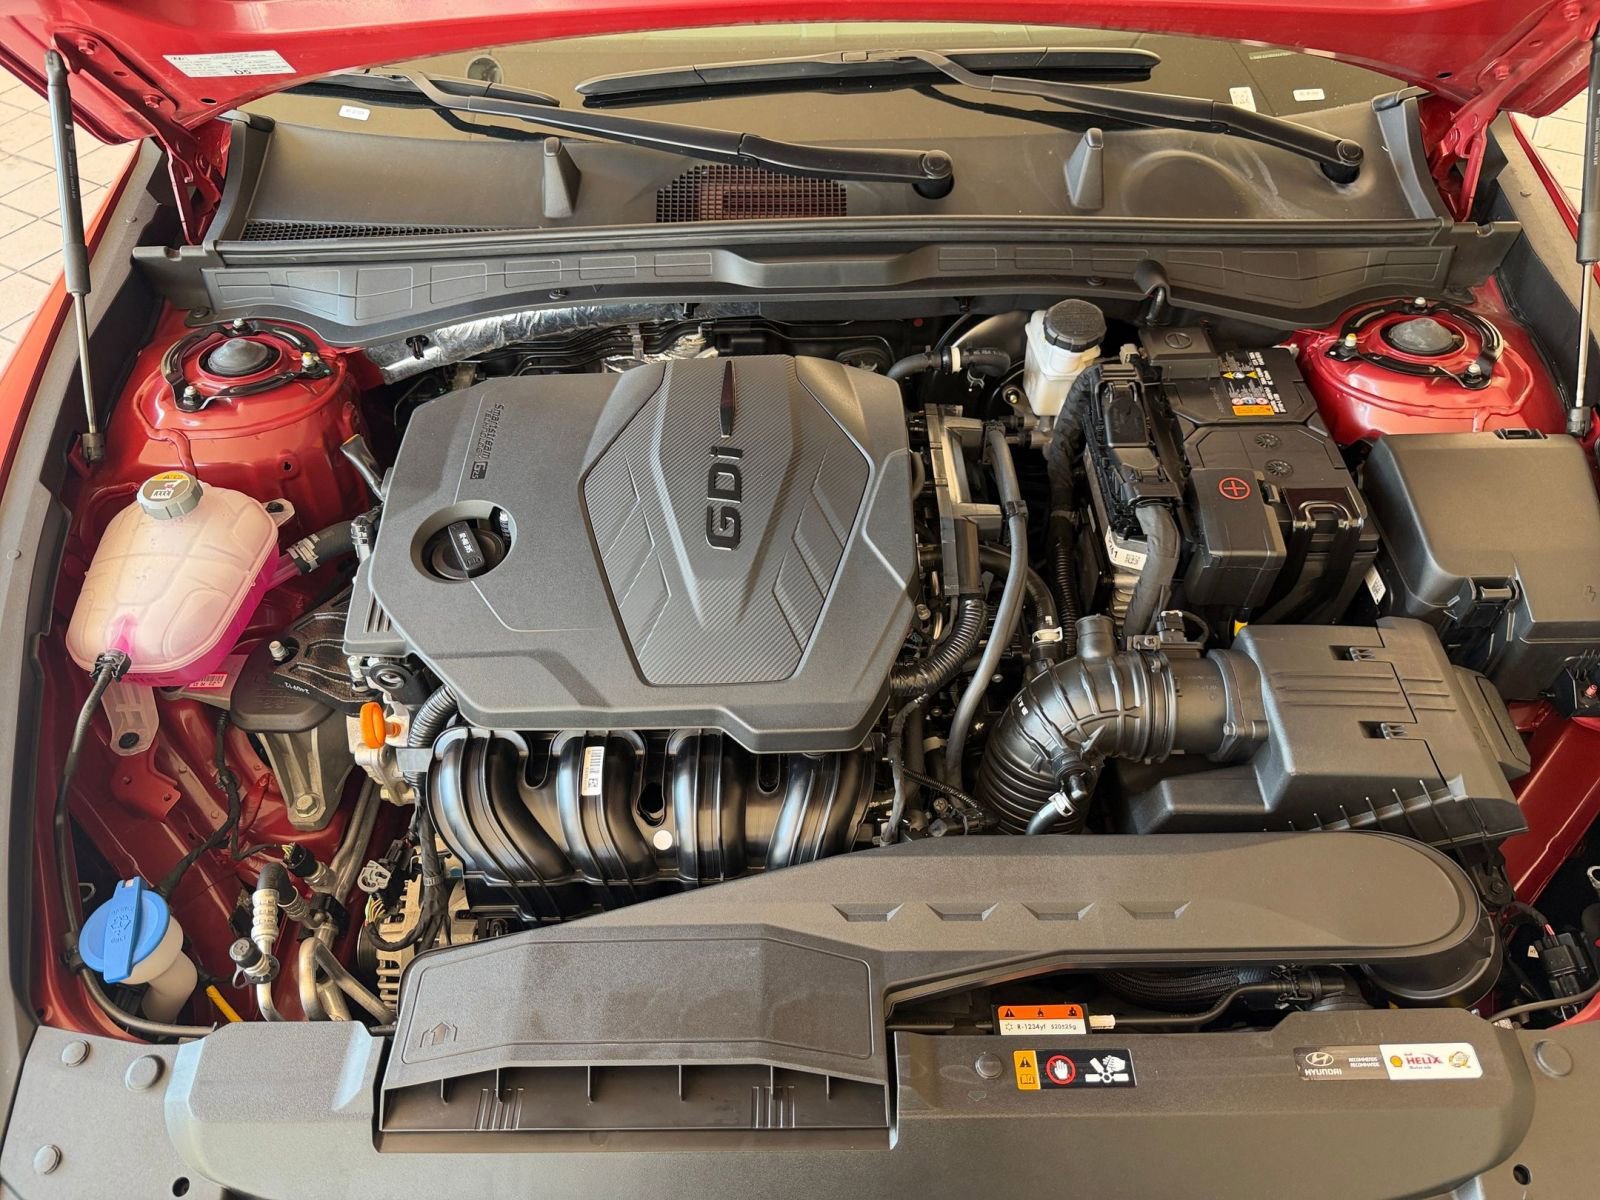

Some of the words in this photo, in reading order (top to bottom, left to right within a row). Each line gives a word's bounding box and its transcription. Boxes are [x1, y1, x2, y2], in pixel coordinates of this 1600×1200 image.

[481, 402, 505, 460] Smartstream
[706, 446, 743, 551] GDi
[1304, 1068, 1342, 1076] HYUNDAI
[1406, 1056, 1441, 1065] HELIX
